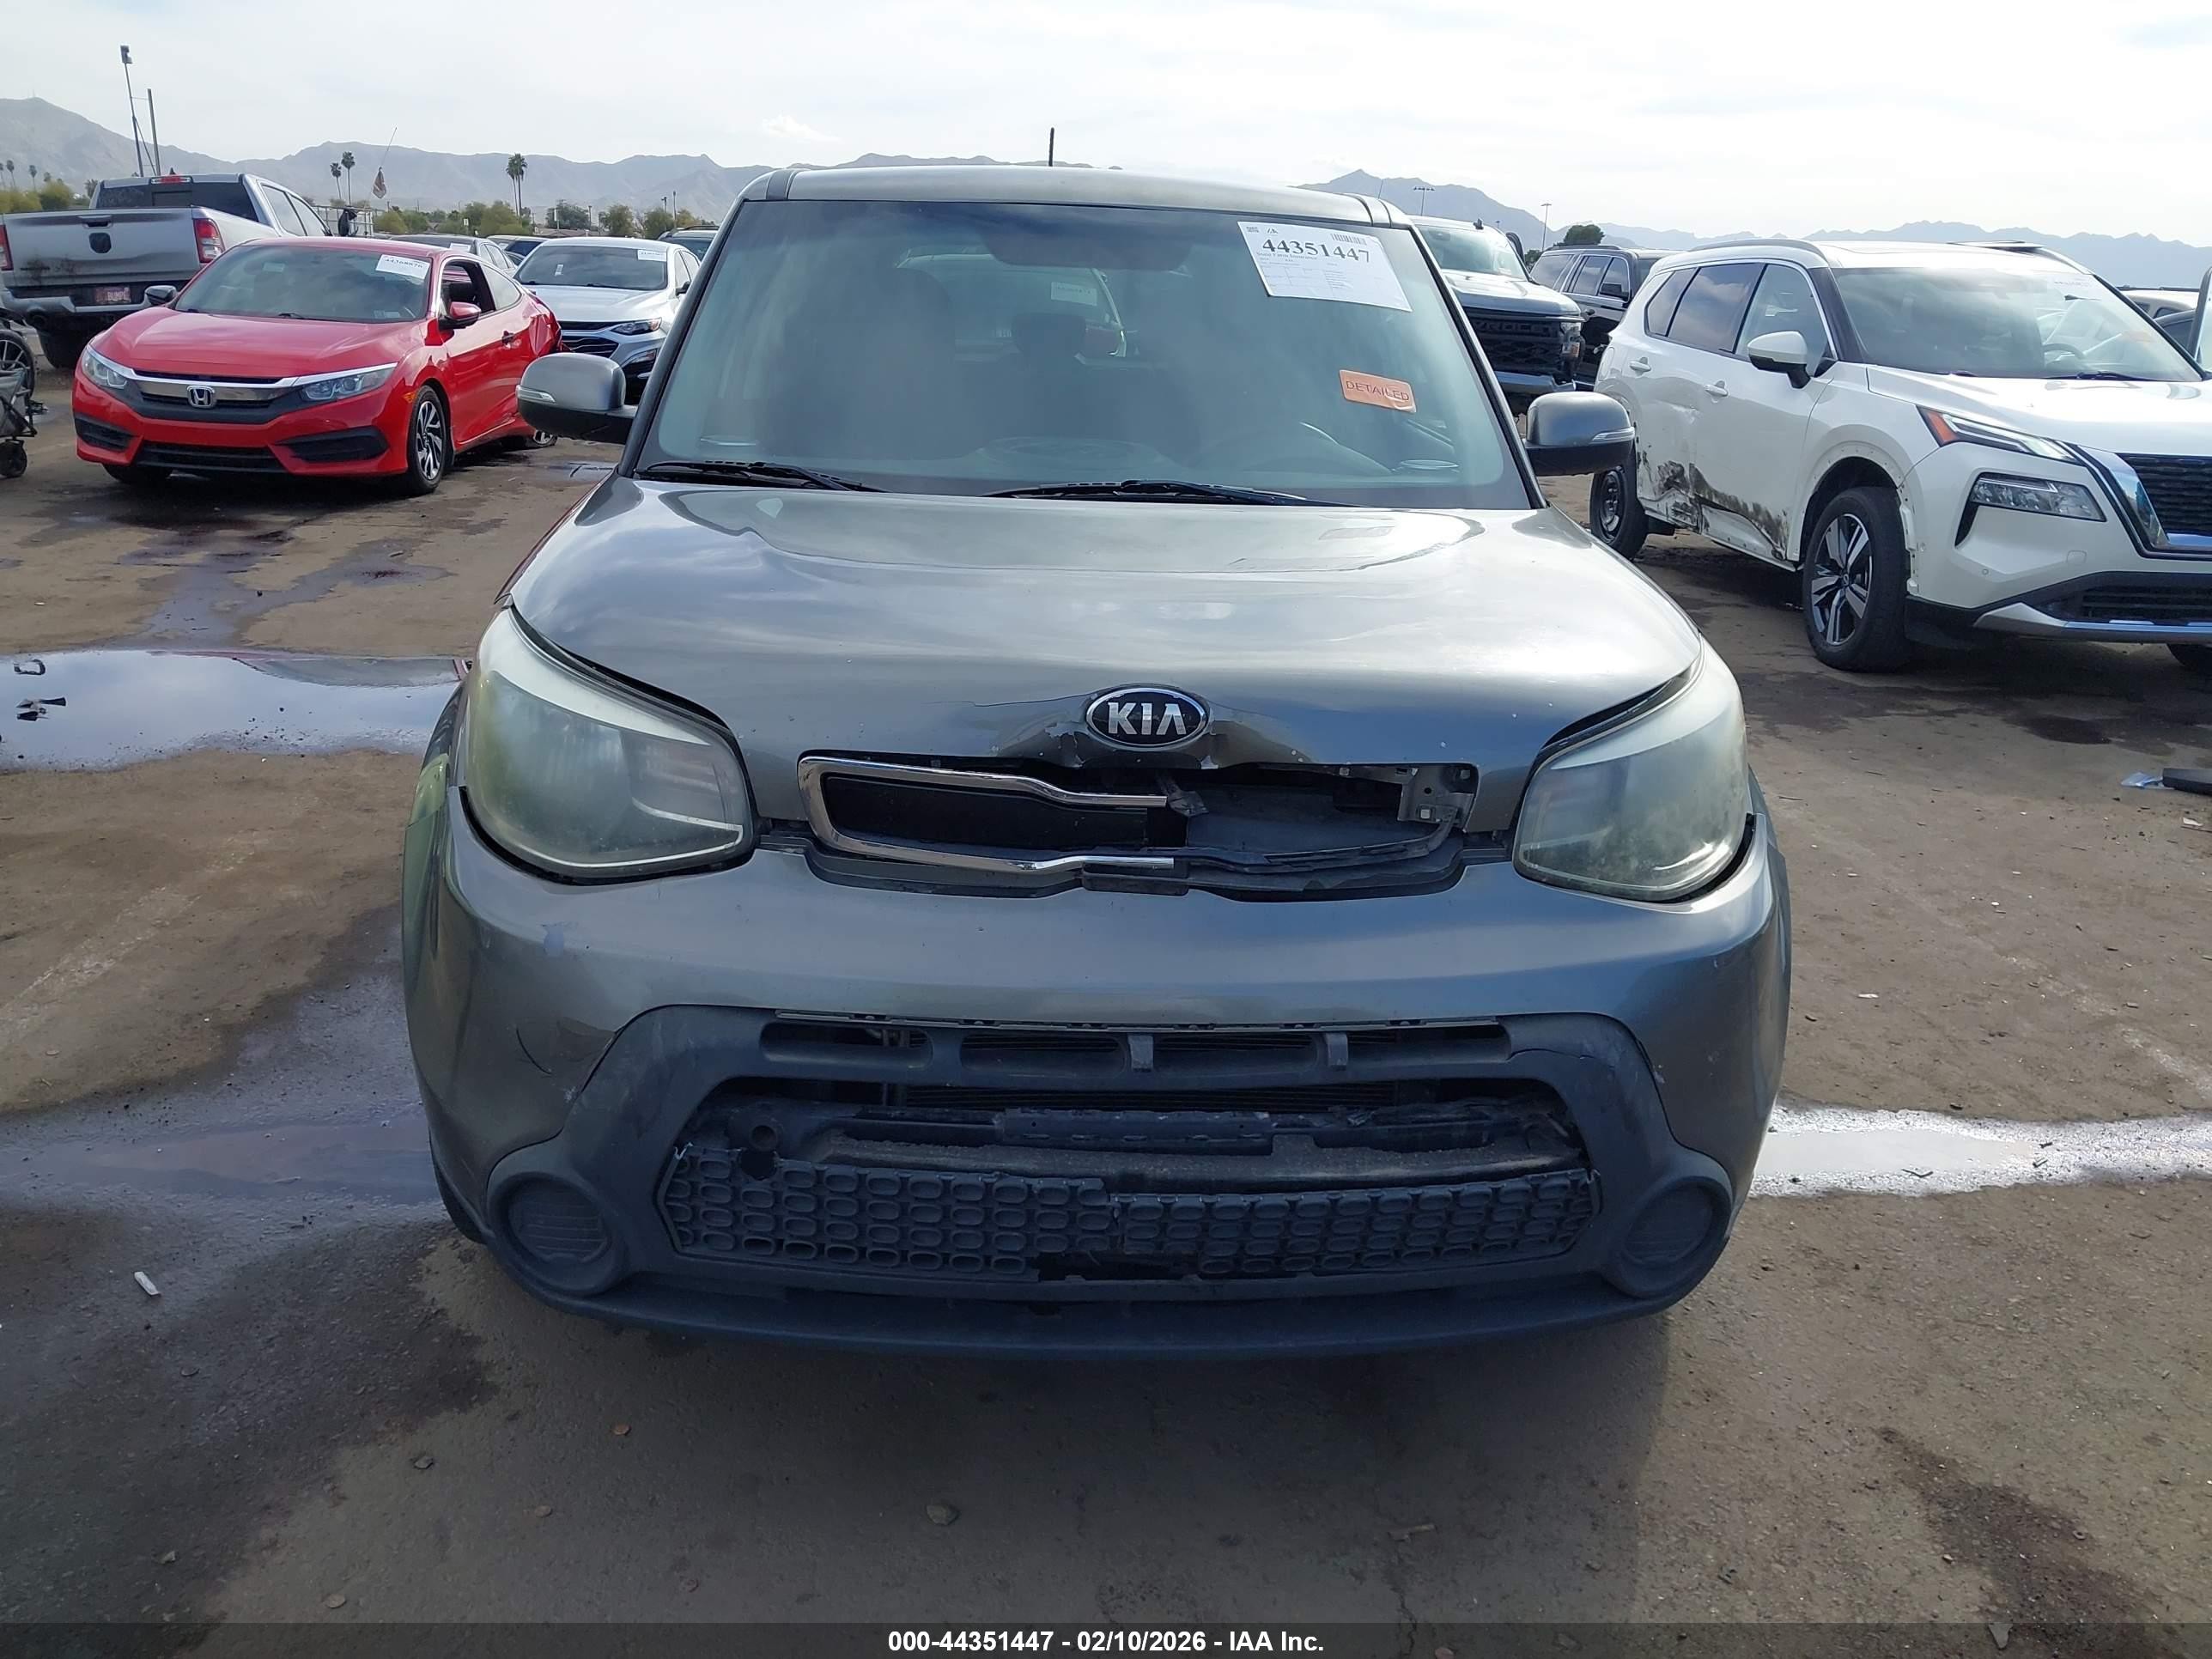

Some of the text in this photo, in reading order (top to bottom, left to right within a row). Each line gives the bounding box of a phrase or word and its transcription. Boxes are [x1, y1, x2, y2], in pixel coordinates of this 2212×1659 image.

[1262, 239, 1370, 263] 44351447
[1346, 380, 1410, 401] DETAILED
[1108, 702, 1187, 735] KIA
